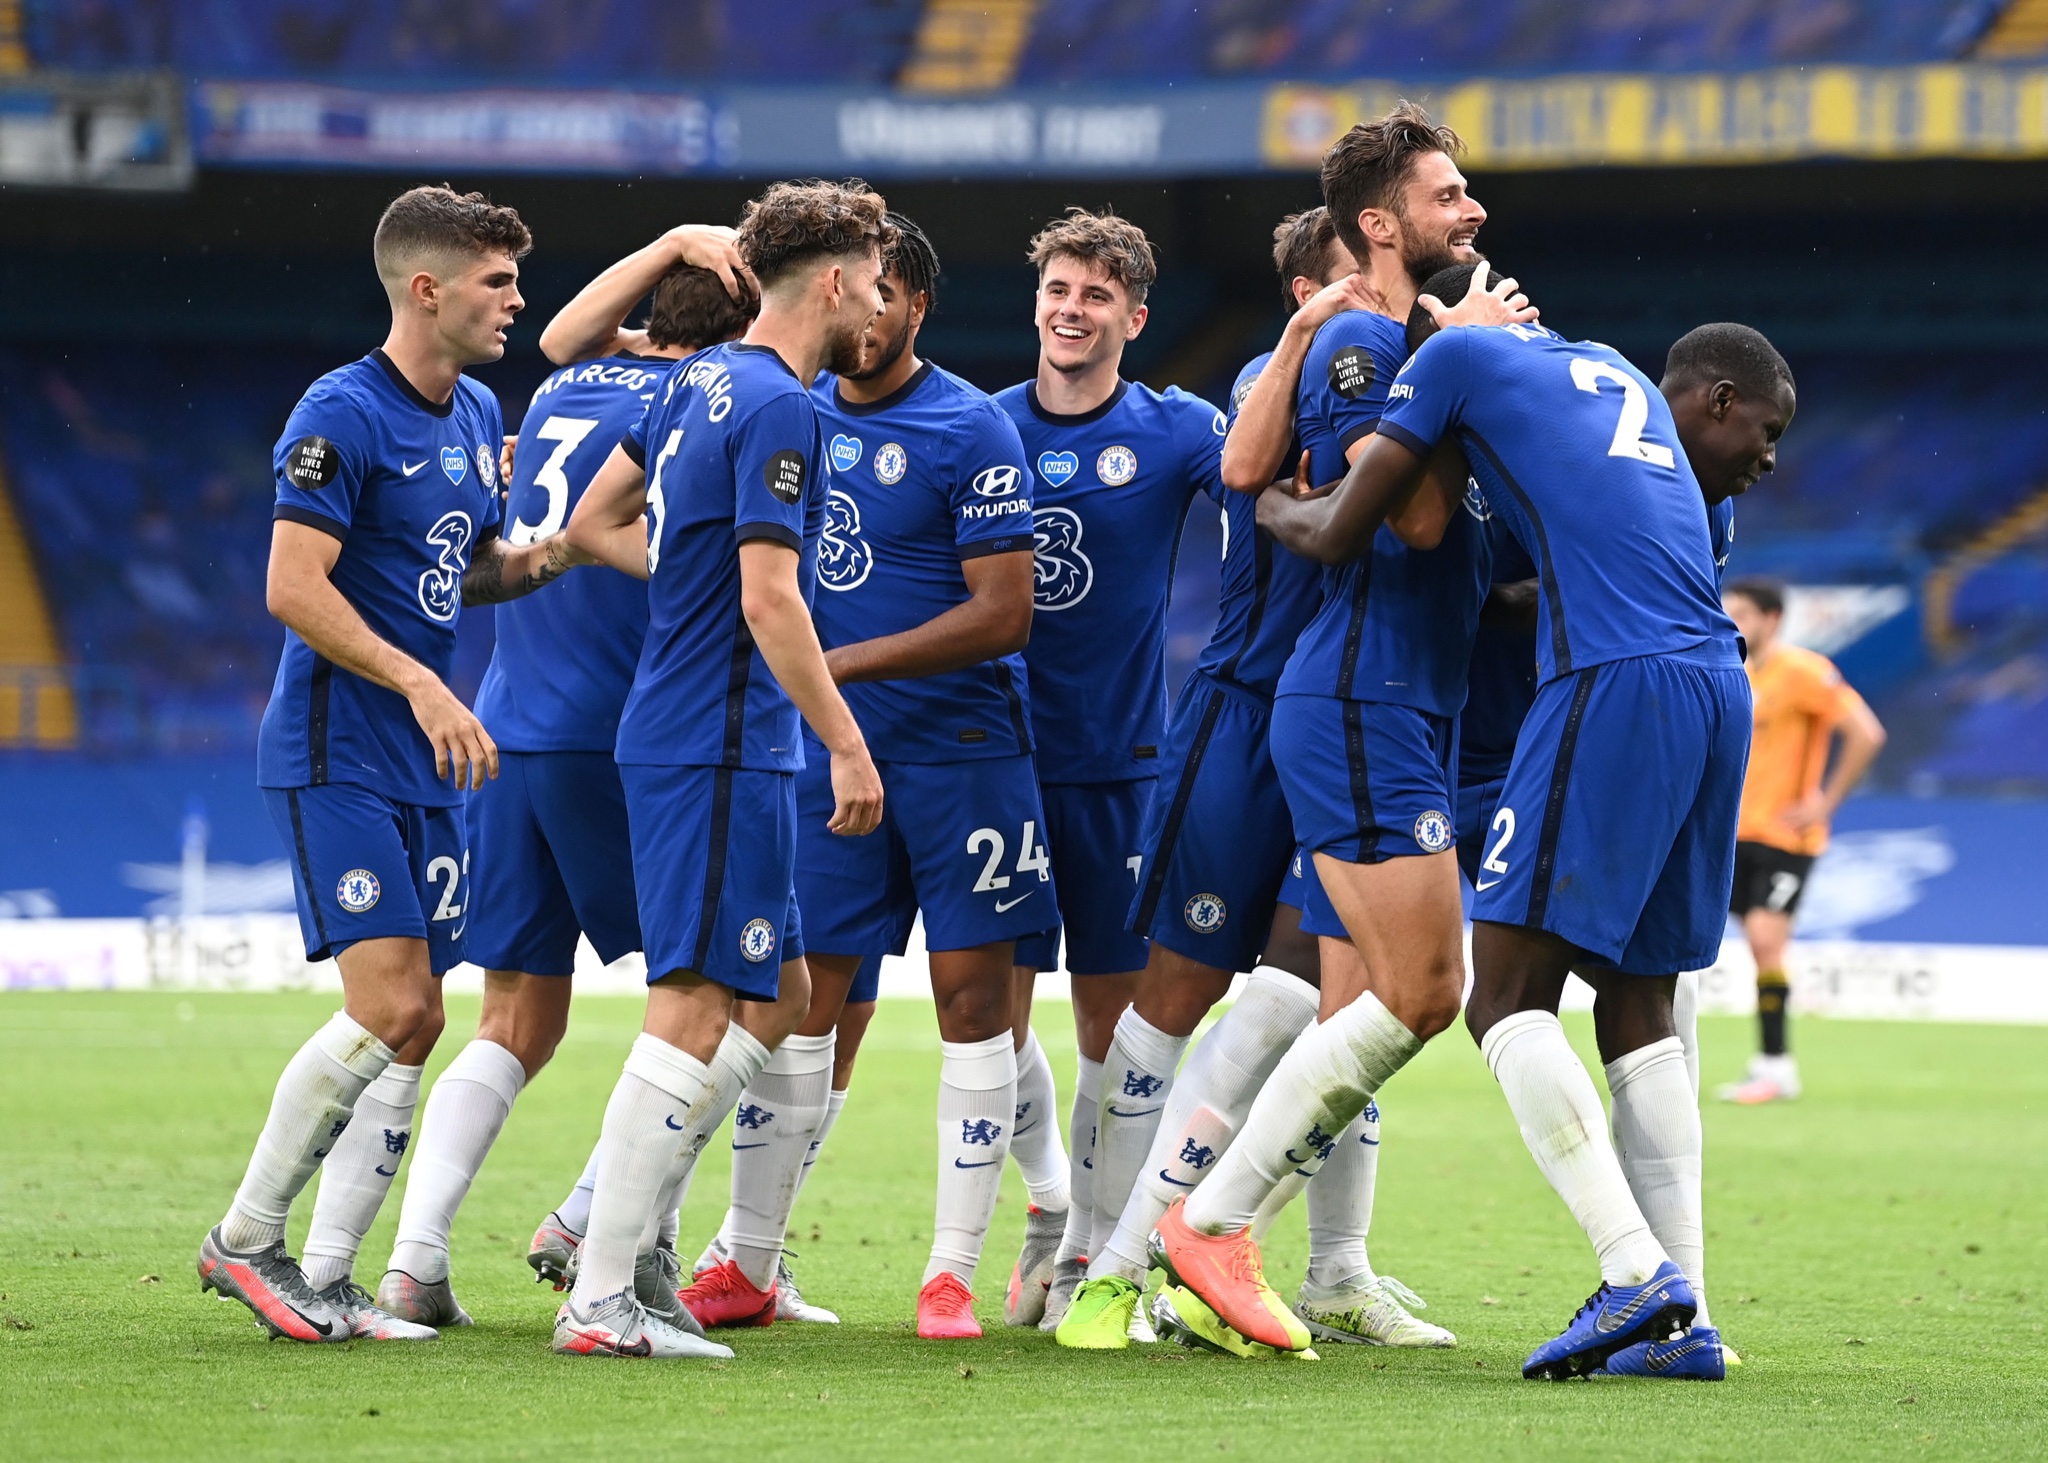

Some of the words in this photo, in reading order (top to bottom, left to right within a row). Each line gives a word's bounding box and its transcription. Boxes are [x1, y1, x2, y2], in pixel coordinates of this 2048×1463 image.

[1338, 366, 1359, 379] LIVES
[1339, 375, 1365, 391] MATTER
[1569, 357, 1675, 469] 2
[836, 446, 855, 459] NHS
[300, 457, 321, 469] LIVES
[446, 458, 463, 469] NHS
[1046, 463, 1070, 473] NHS
[294, 467, 322, 481] MATTER
[504, 415, 599, 546] 3
[780, 470, 798, 484] LIVES
[775, 480, 798, 495] MATTER
[1483, 808, 1516, 874] 2
[966, 820, 1050, 893] 24
